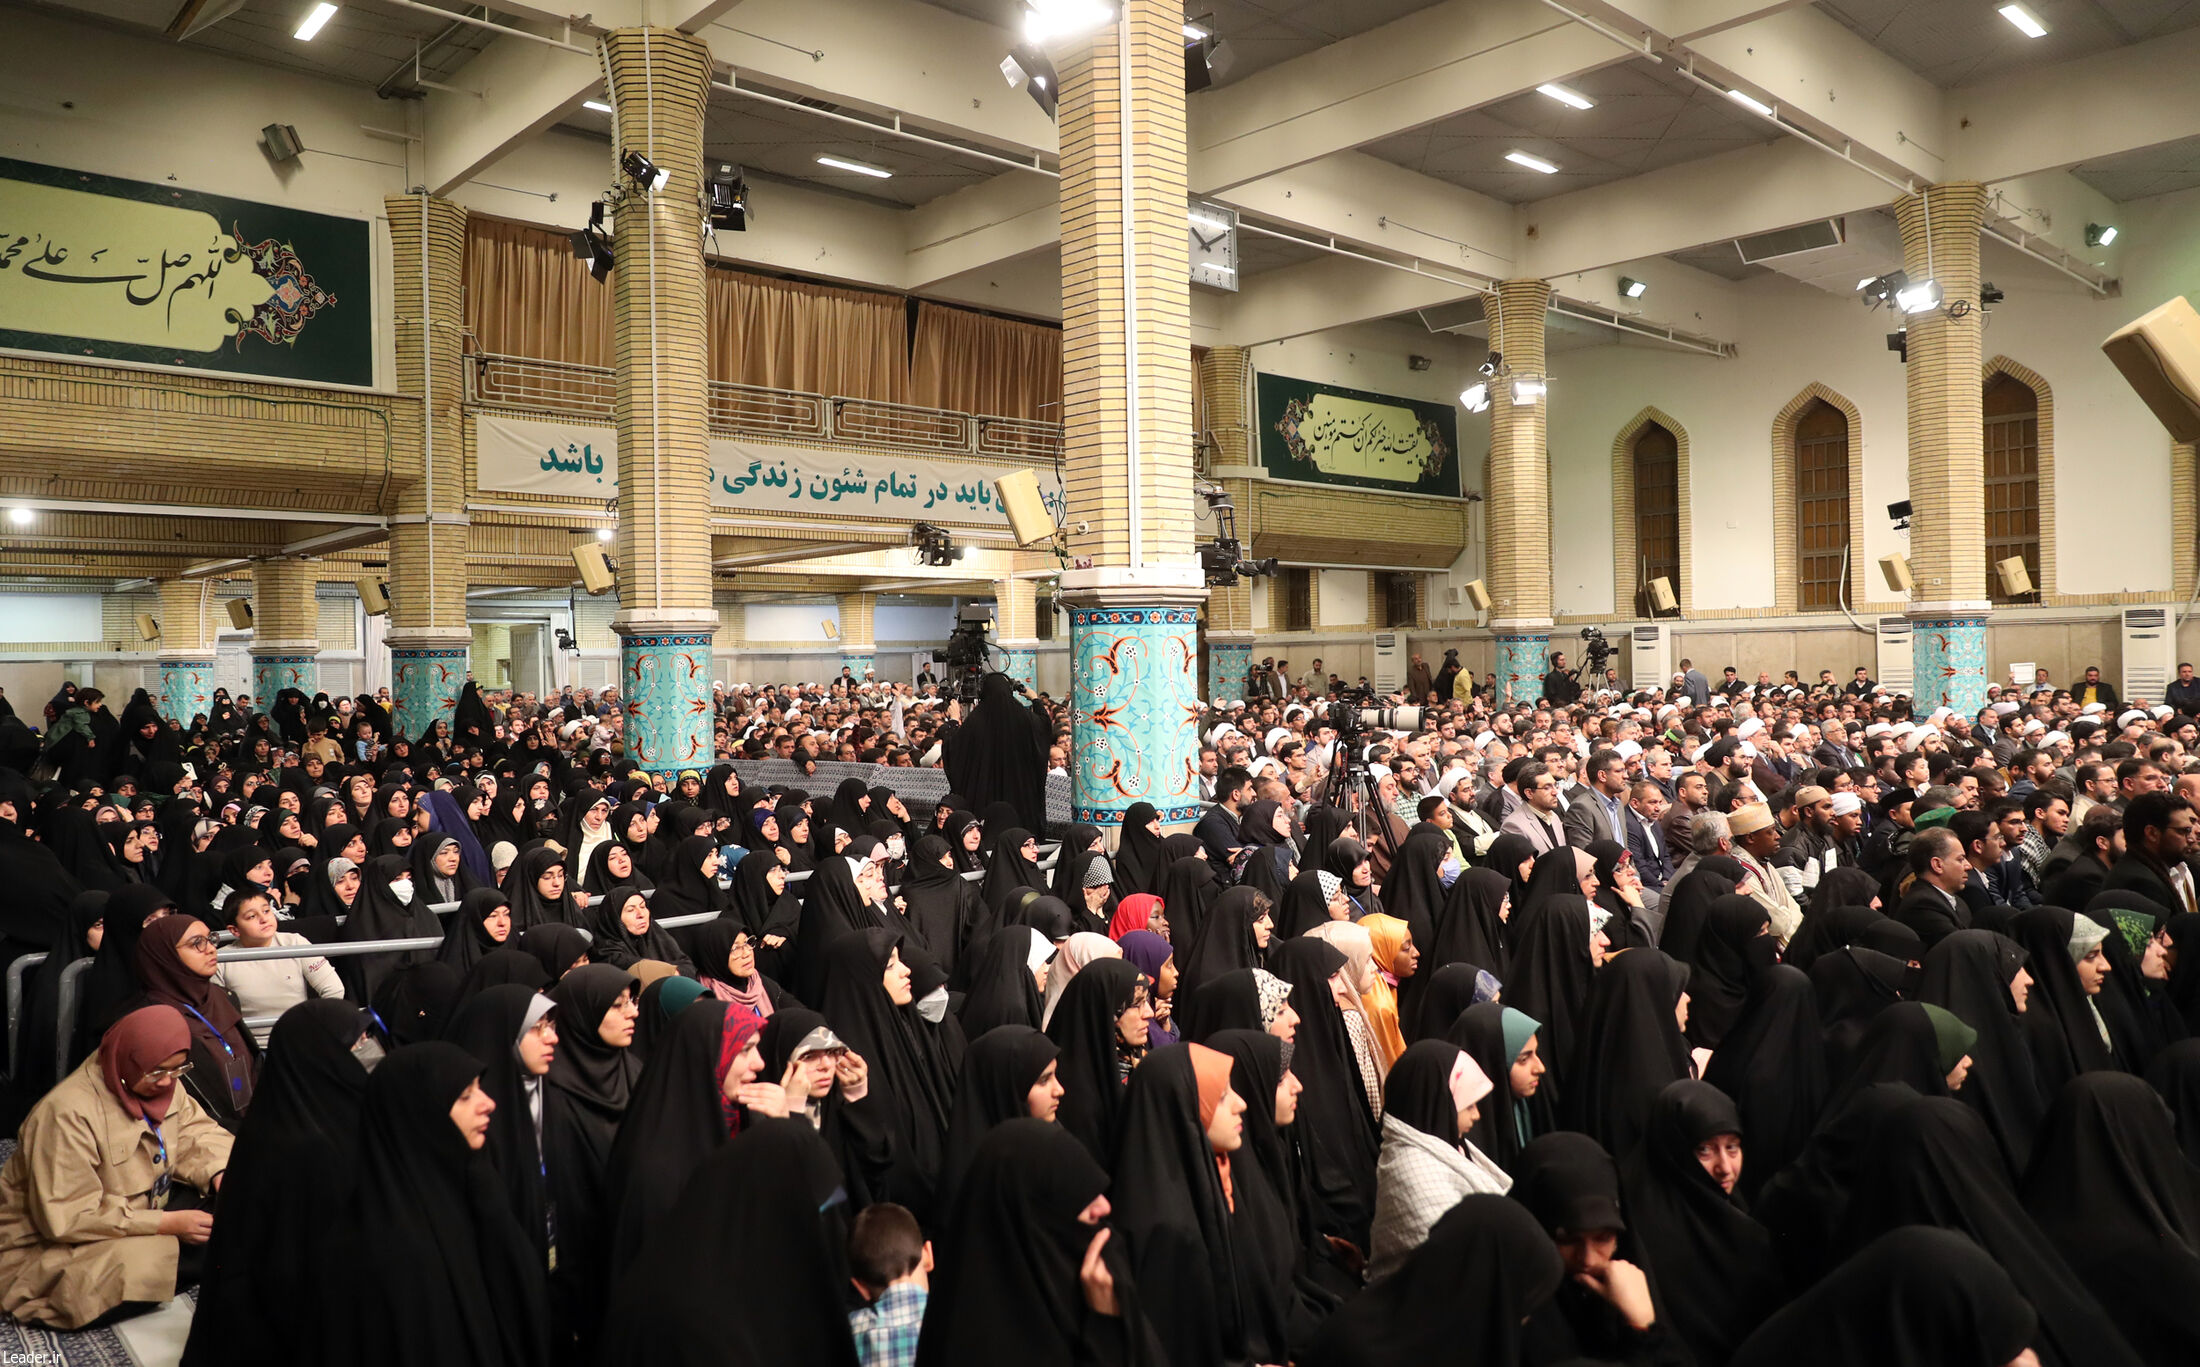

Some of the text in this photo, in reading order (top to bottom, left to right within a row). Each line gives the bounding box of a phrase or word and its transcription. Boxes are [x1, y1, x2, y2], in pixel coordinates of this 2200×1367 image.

[539, 443, 605, 484] باشد
[722, 458, 802, 499] زندگی
[809, 467, 868, 501] شئون
[874, 471, 917, 504] تمام
[923, 481, 948, 508] در
[955, 480, 991, 512] باید
